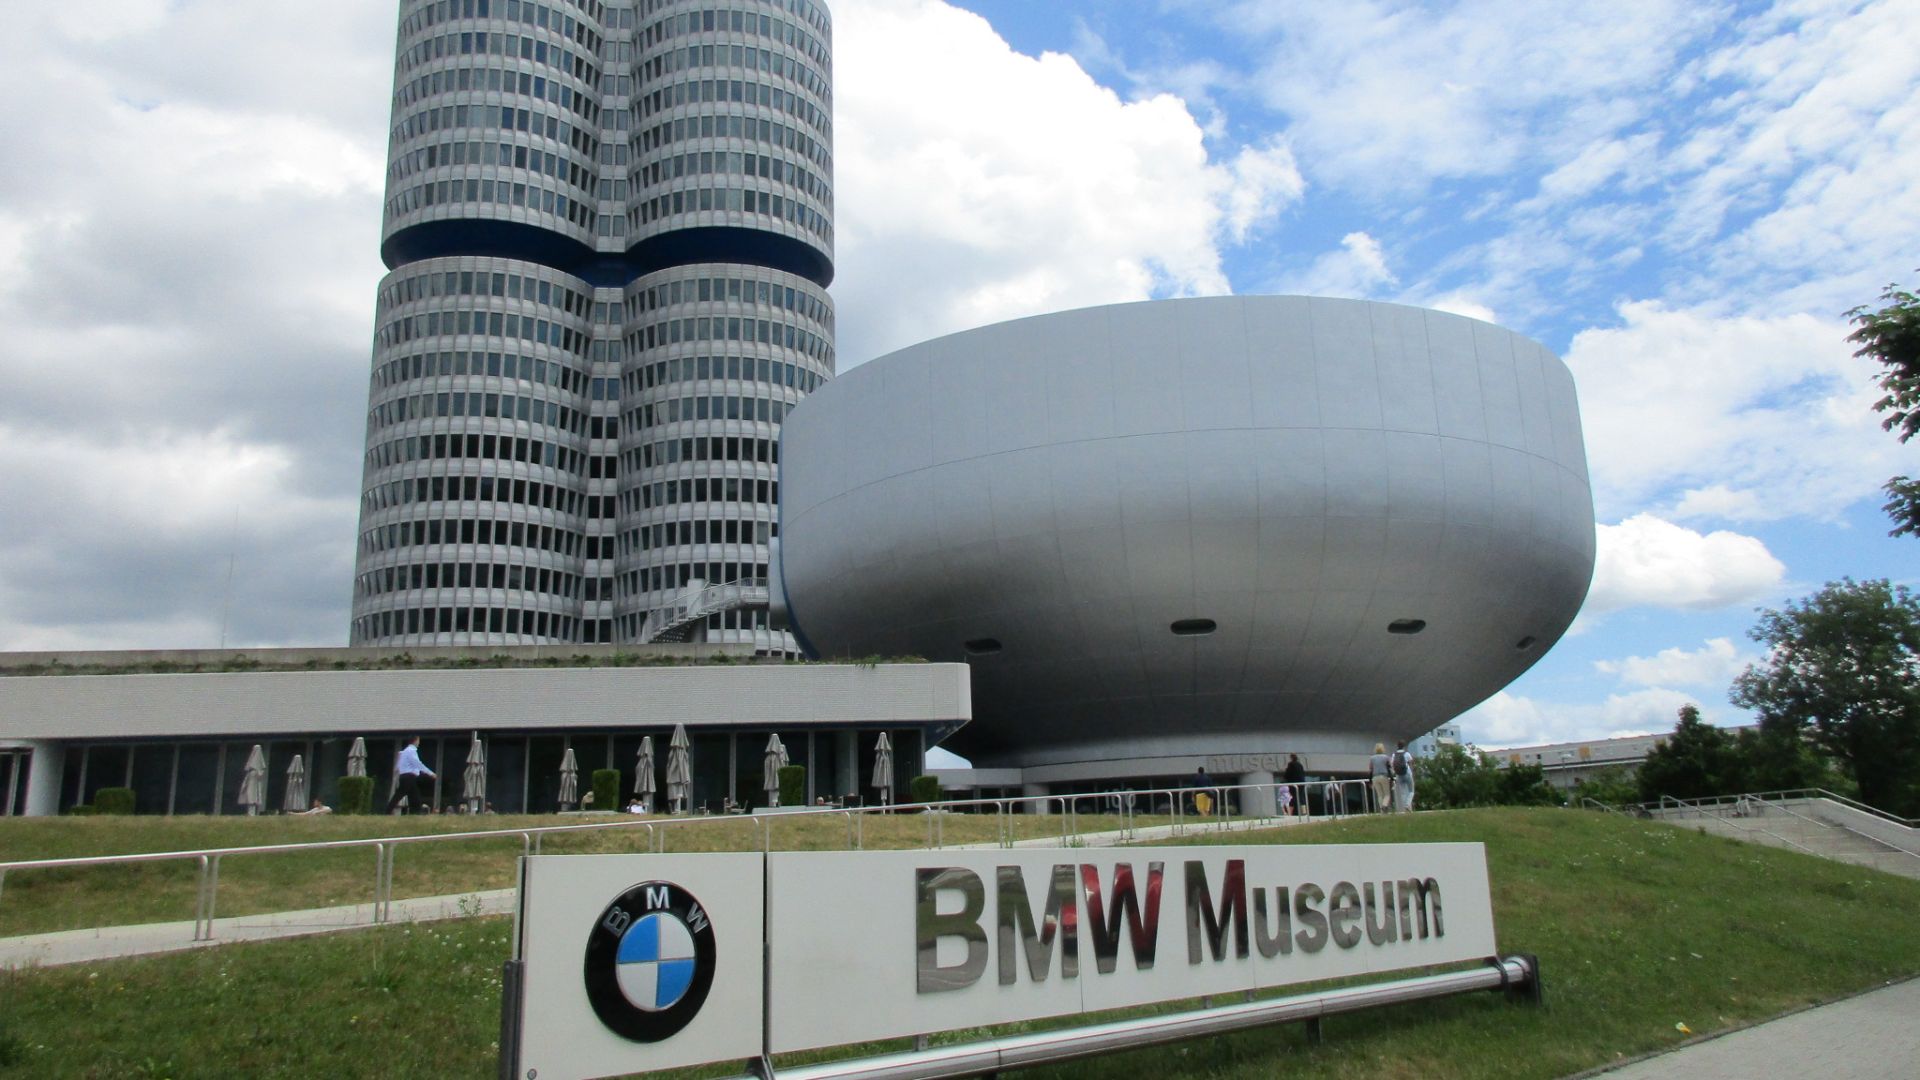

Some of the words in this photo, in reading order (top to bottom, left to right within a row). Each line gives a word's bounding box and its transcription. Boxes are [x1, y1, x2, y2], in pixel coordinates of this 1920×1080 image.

[602, 886, 709, 937] BMW
[916, 861, 1165, 994] BMW
[1184, 859, 1444, 966] Museum
